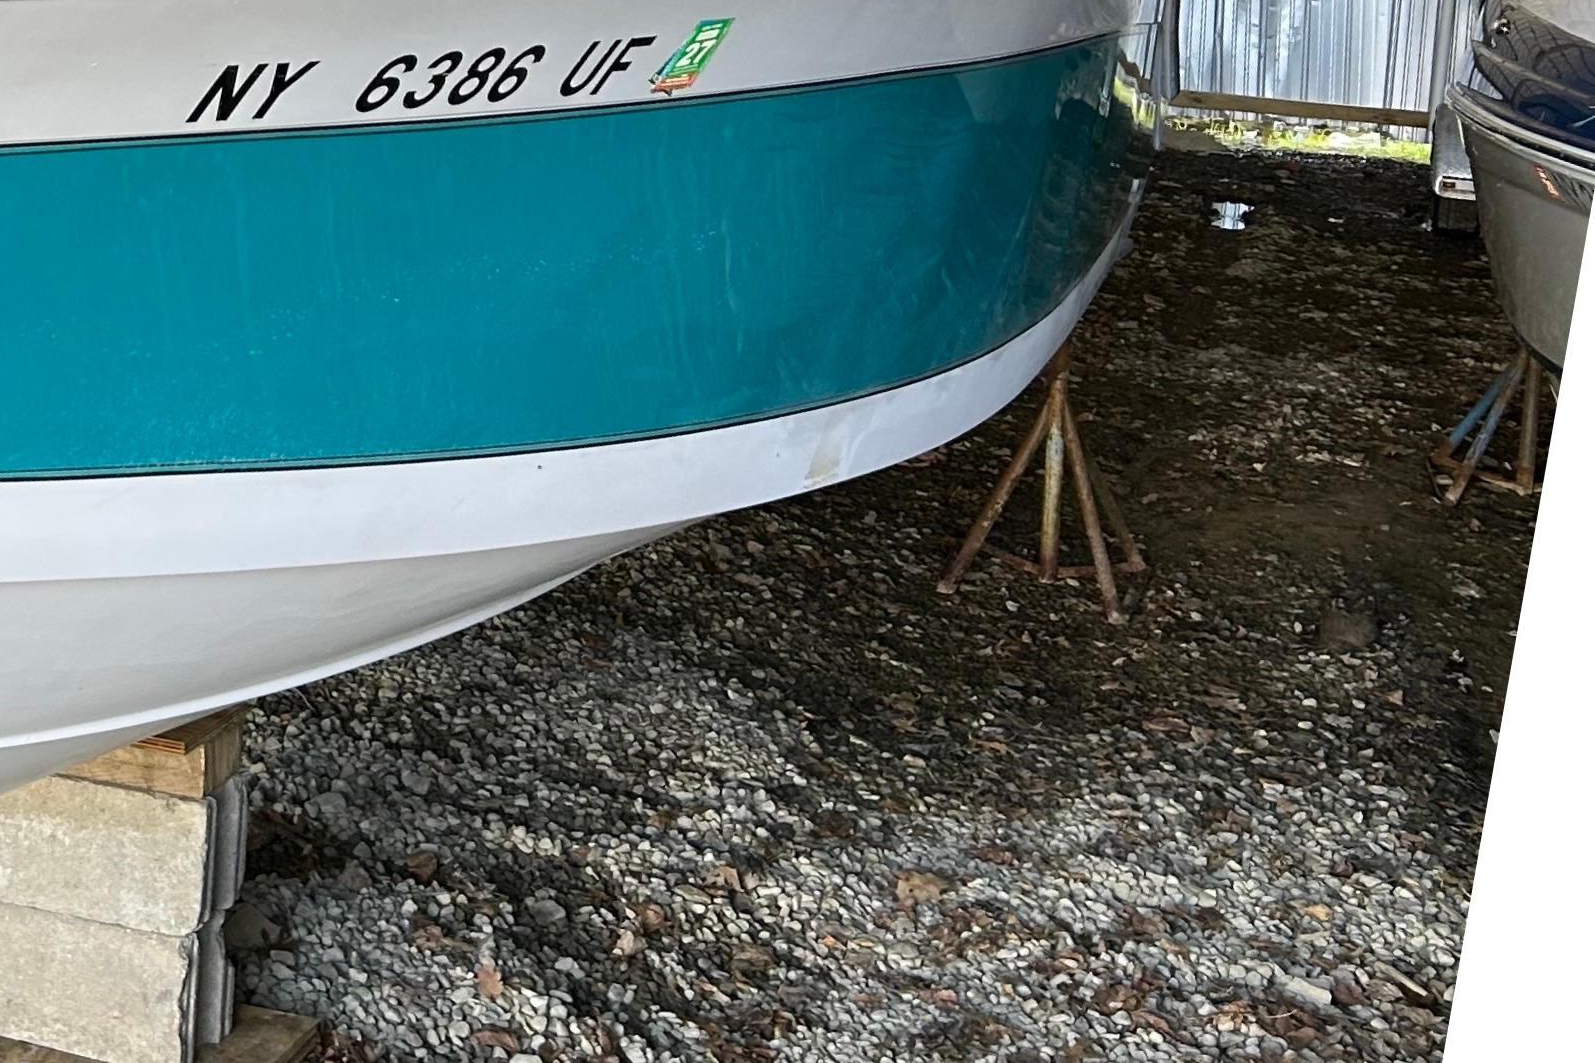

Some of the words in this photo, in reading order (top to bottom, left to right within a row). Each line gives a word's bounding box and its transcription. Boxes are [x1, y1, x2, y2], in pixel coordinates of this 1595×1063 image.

[185, 60, 321, 123] NY
[355, 44, 546, 113] 6386
[559, 35, 658, 97] UF
[674, 39, 718, 67] 27
